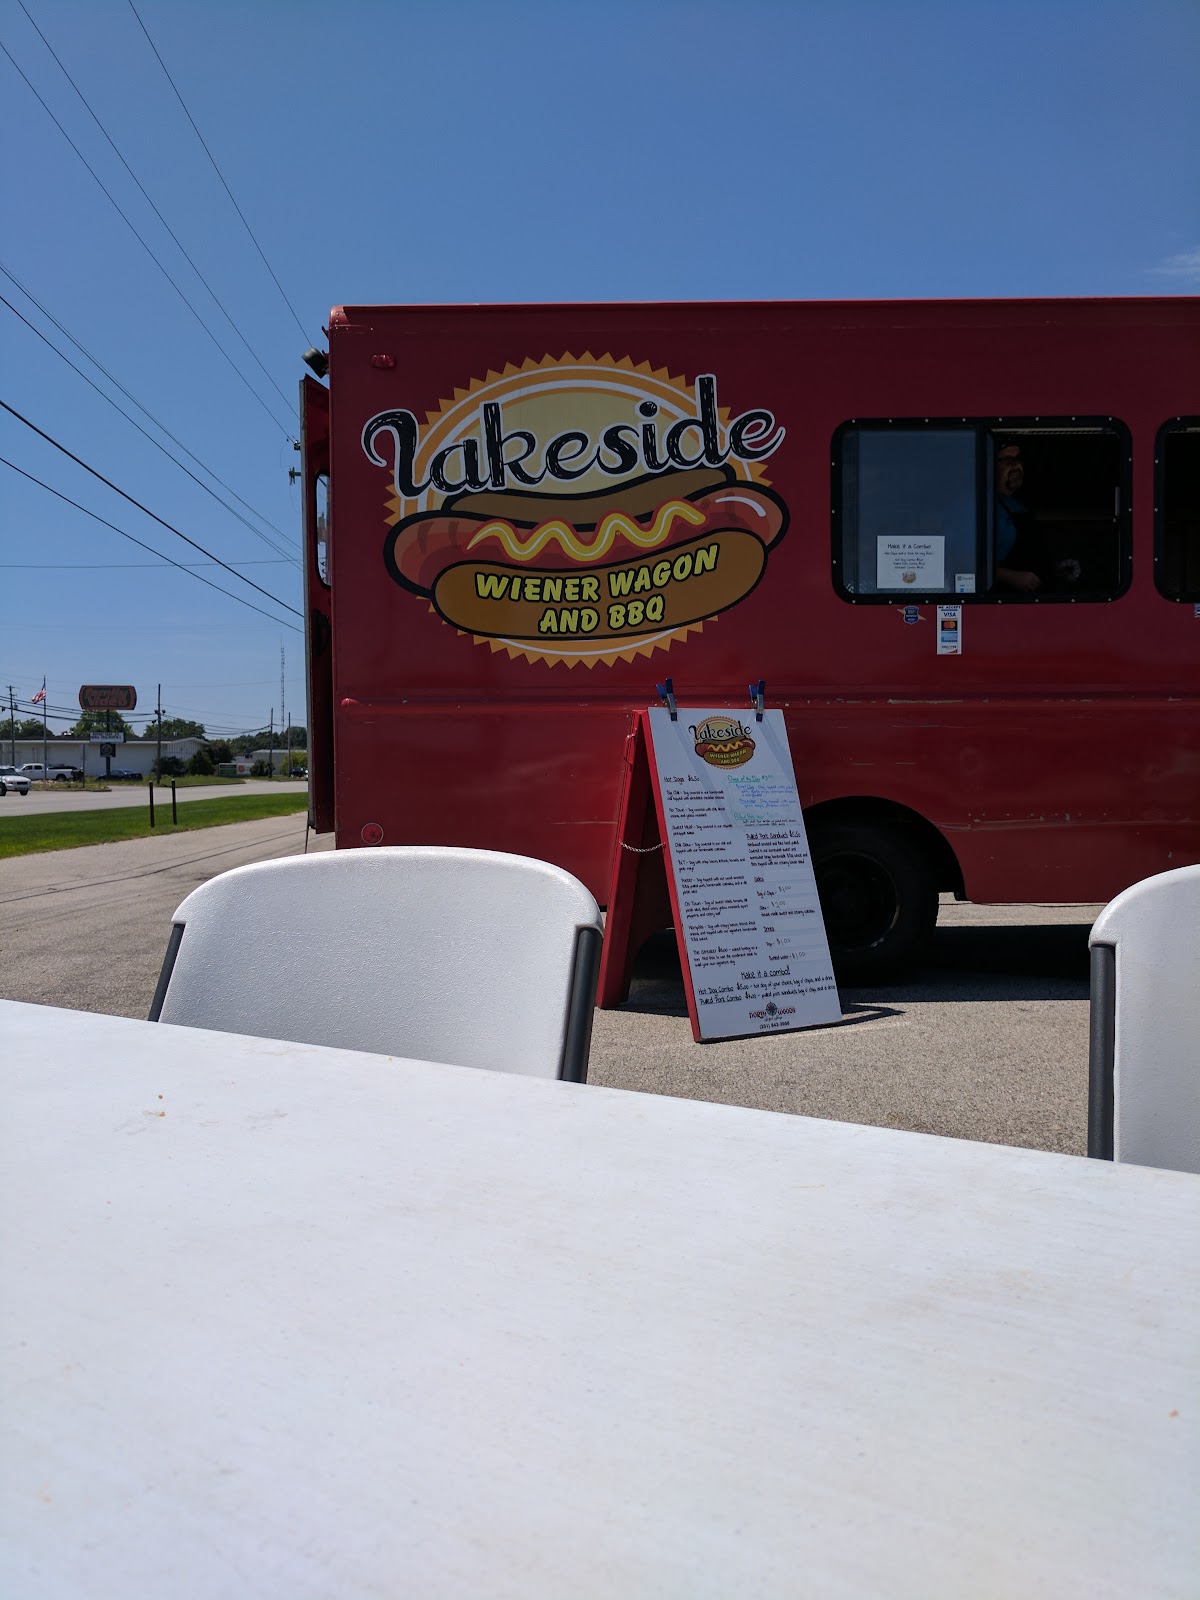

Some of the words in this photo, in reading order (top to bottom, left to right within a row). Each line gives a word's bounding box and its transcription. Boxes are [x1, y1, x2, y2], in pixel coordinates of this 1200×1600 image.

[362, 374, 786, 497] Lakeside
[475, 573, 601, 603] WIENER
[608, 543, 720, 597] WAGON
[538, 606, 600, 634] AND
[608, 594, 664, 631] BBQ
[688, 720, 752, 740] Lakeside
[673, 776, 684, 785] Dogs
[740, 970, 756, 979] Make
[769, 965, 790, 976] combo!
[698, 987, 707, 995] Hot
[708, 985, 718, 996] Dog
[718, 985, 734, 993] Combo
[700, 996, 713, 1005] Pulled
[714, 995, 726, 1003] Pork
[726, 994, 742, 1002] Combo
